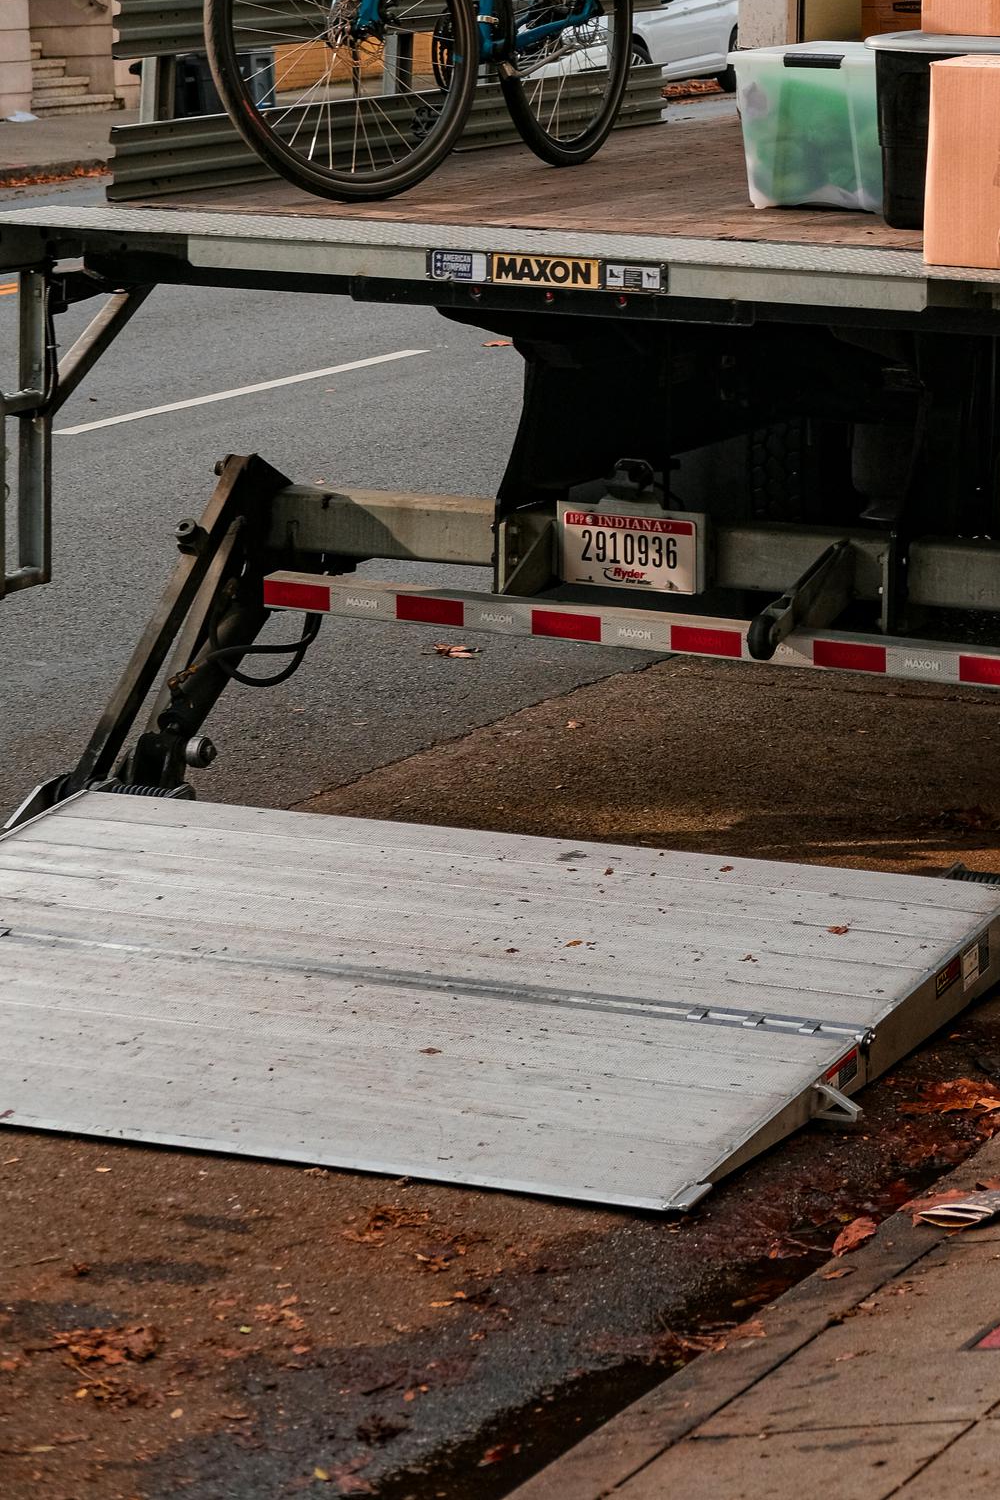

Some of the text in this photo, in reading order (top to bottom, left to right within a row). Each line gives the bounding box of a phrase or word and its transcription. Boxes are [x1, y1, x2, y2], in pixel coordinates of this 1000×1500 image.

[495, 257, 592, 285] MAXON
[569, 514, 663, 532] APP INDIANA
[581, 529, 677, 570] 2910936
[613, 567, 645, 580] Ryder
[346, 597, 378, 609] MAXON
[481, 612, 513, 624] MAXON
[619, 627, 652, 640] MAXON
[904, 658, 939, 672] MAXON
